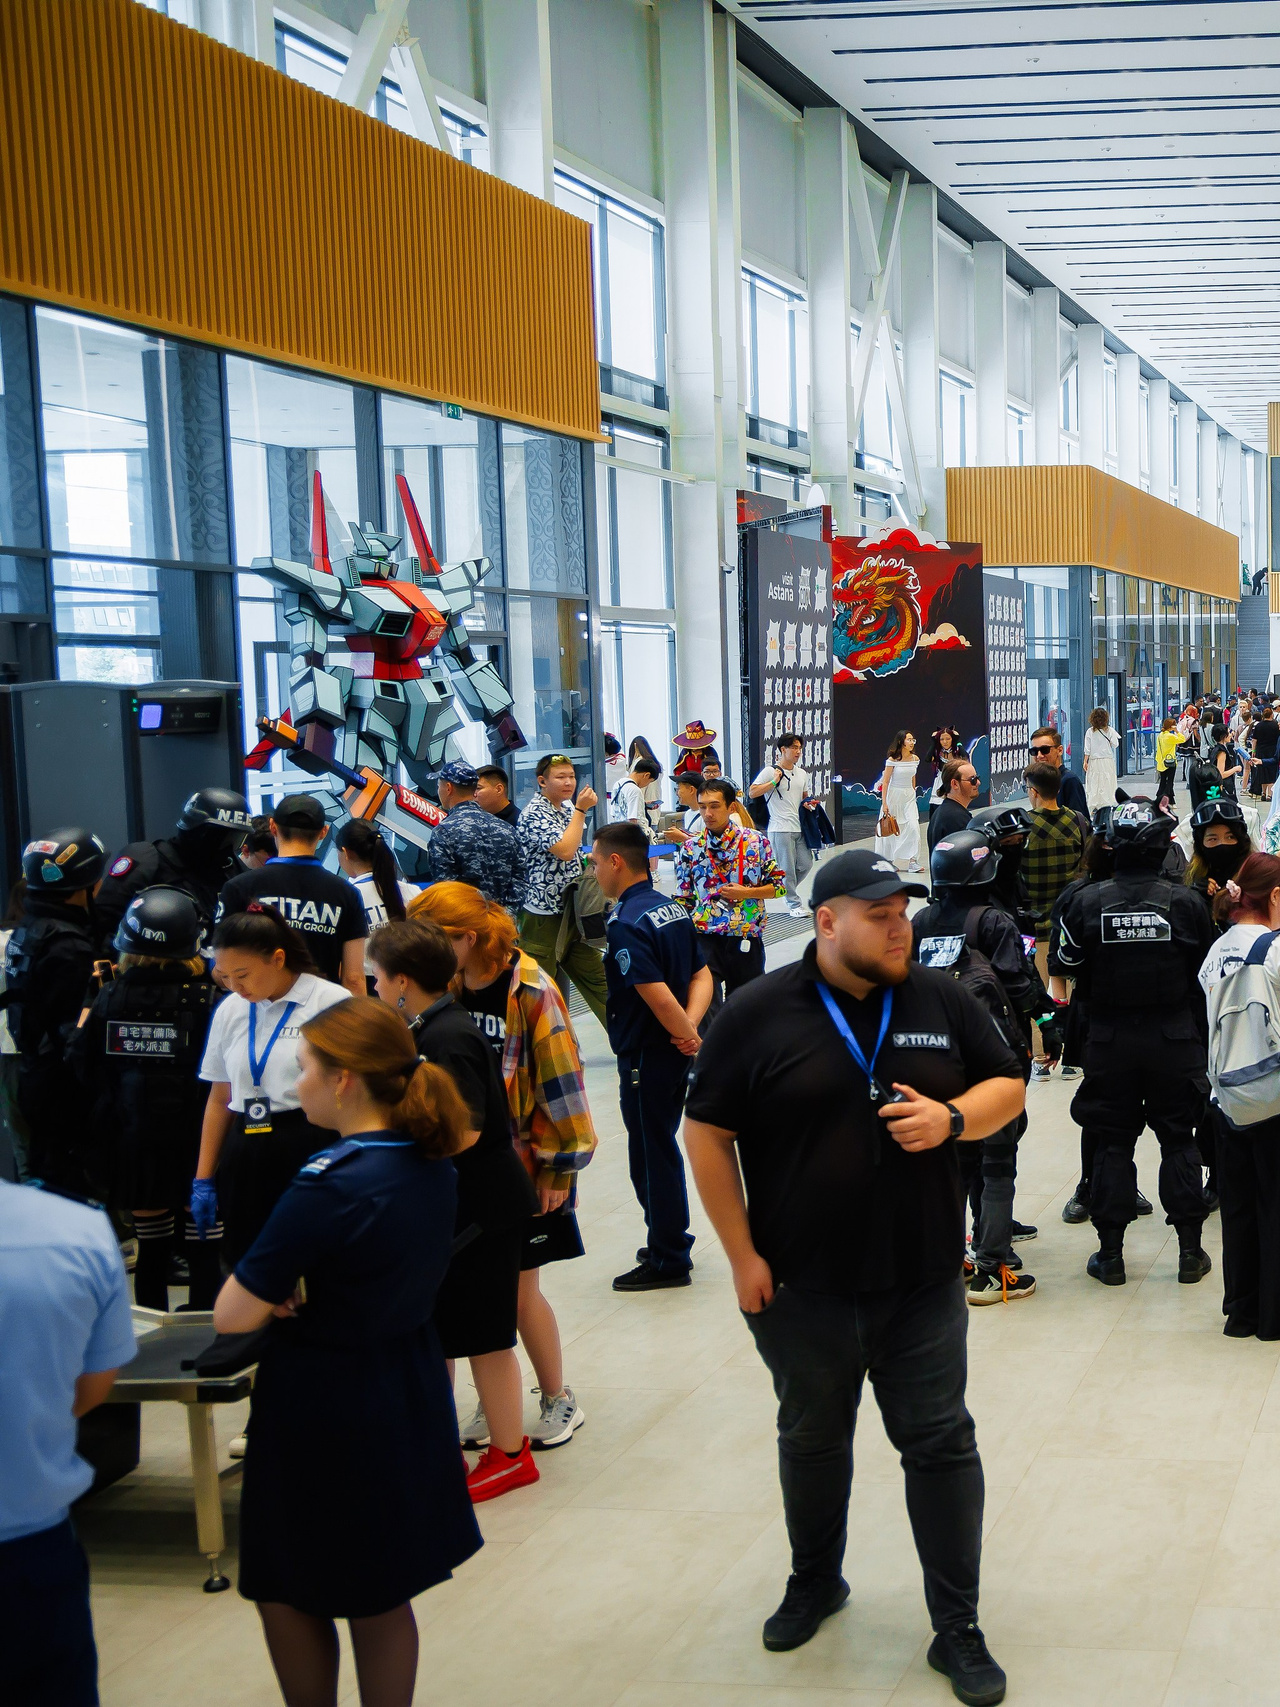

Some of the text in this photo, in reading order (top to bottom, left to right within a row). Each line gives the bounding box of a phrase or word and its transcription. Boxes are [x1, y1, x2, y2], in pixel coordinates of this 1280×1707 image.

[782, 571, 794, 586] visit
[767, 582, 794, 602] Astana
[303, 922, 336, 935] GROUP
[908, 1033, 947, 1047] TITAN
